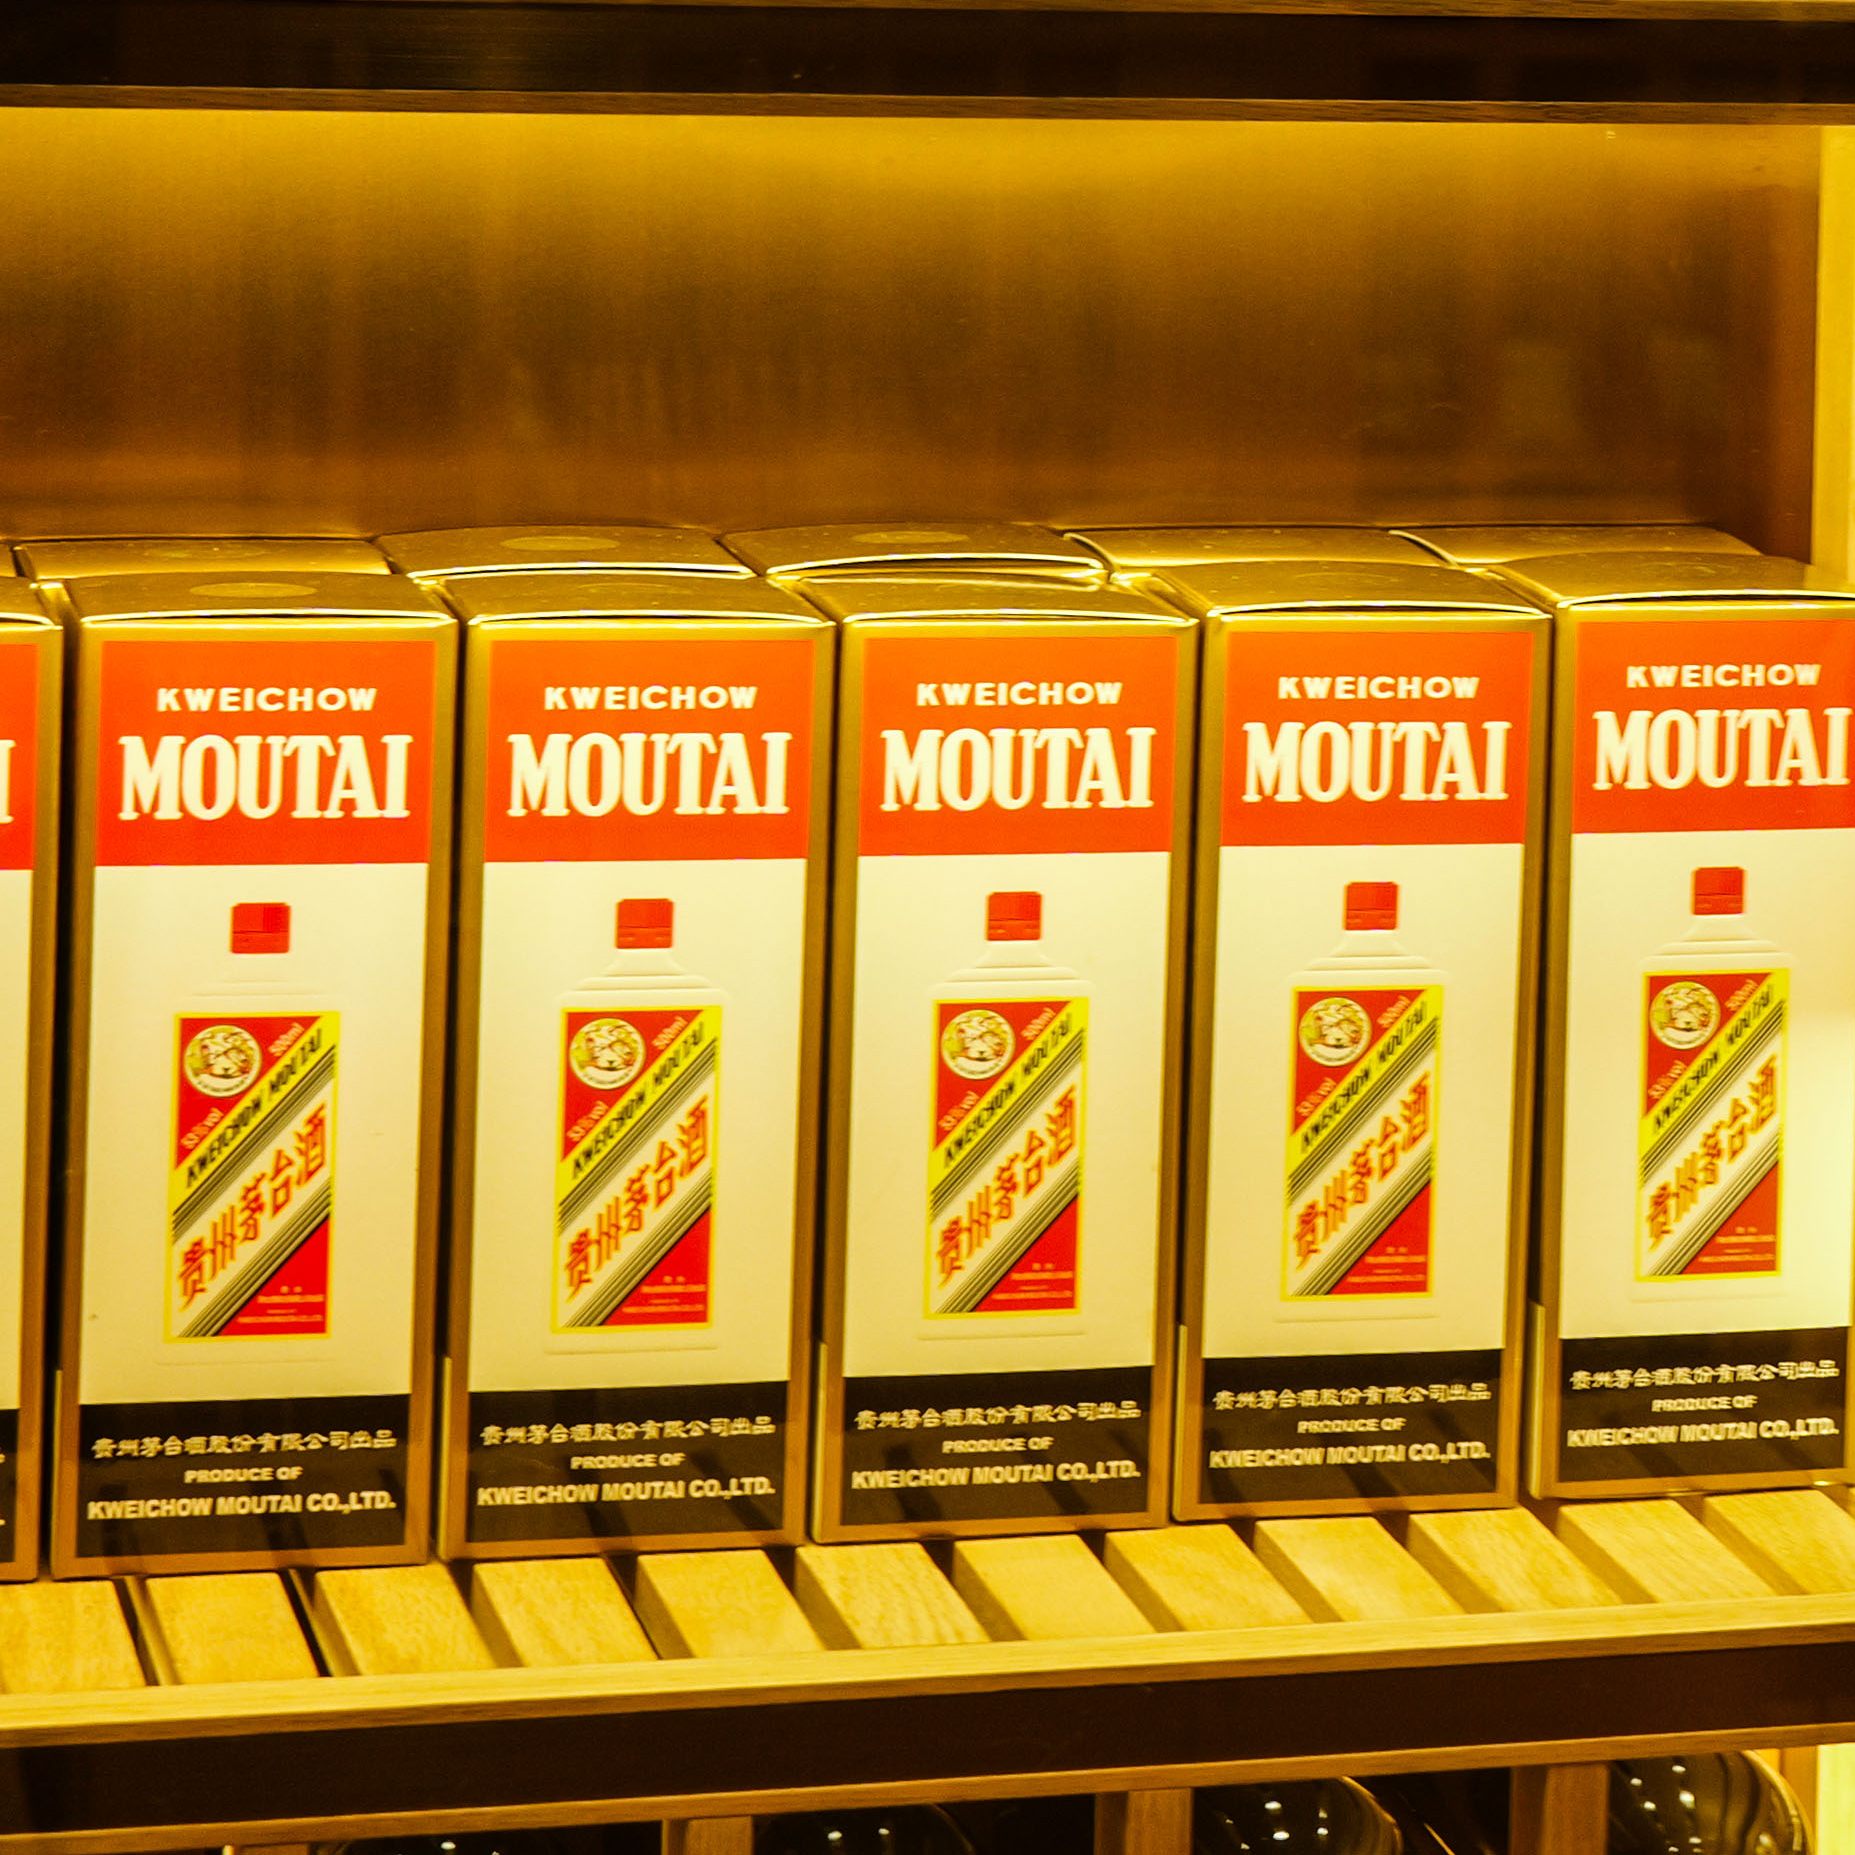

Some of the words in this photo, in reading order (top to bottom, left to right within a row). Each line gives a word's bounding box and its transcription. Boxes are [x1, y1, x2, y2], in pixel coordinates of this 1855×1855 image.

[1278, 676, 1480, 699] KWEICHOW
[1626, 664, 1822, 688] KWEICHOW
[157, 687, 378, 712] KWEICHOW
[544, 685, 758, 710] KWEICHOW
[916, 681, 1123, 706] KWEICHOW
[1592, 707, 1853, 790] MOUTAI
[506, 732, 793, 817] MOUTAI
[880, 727, 1157, 812] MOUTAI
[1242, 721, 1513, 803] MOUTAI
[118, 734, 414, 820] MOUTAI
[1646, 1053, 1777, 1252] 贵州茅台酒
[1292, 1070, 1430, 1271] 贵州茅台酒
[564, 1094, 709, 1303] 贵州茅台酒
[936, 1083, 1076, 1289] 贵州茅台酒
[177, 1102, 327, 1312] 贵州茅台酒
[1651, 1397, 1732, 1412] PRODUCE
[1732, 1395, 1759, 1408] OF
[1297, 1419, 1380, 1434] PRODUCE
[1380, 1418, 1407, 1431] OF
[1567, 1425, 1679, 1447] KWEICHOW
[1680, 1422, 1757, 1442] MOUTAI
[942, 1439, 1027, 1454] PRODUCE
[1027, 1437, 1054, 1451] OF
[1209, 1448, 1325, 1469] KWEICHOW
[1326, 1444, 1406, 1465] MOUTAI
[570, 1454, 657, 1470] PRODUCE
[658, 1452, 686, 1466] OF
[185, 1467, 274, 1484] PRODUCE
[275, 1466, 303, 1481] OF
[851, 1467, 971, 1489] KWEICHOW
[972, 1464, 1054, 1485] MOUTAI
[477, 1483, 599, 1506] KWEICHOW
[601, 1480, 686, 1502] MOUTAI
[87, 1497, 214, 1521] KWEICHOW
[215, 1494, 302, 1516] MOUTAI
